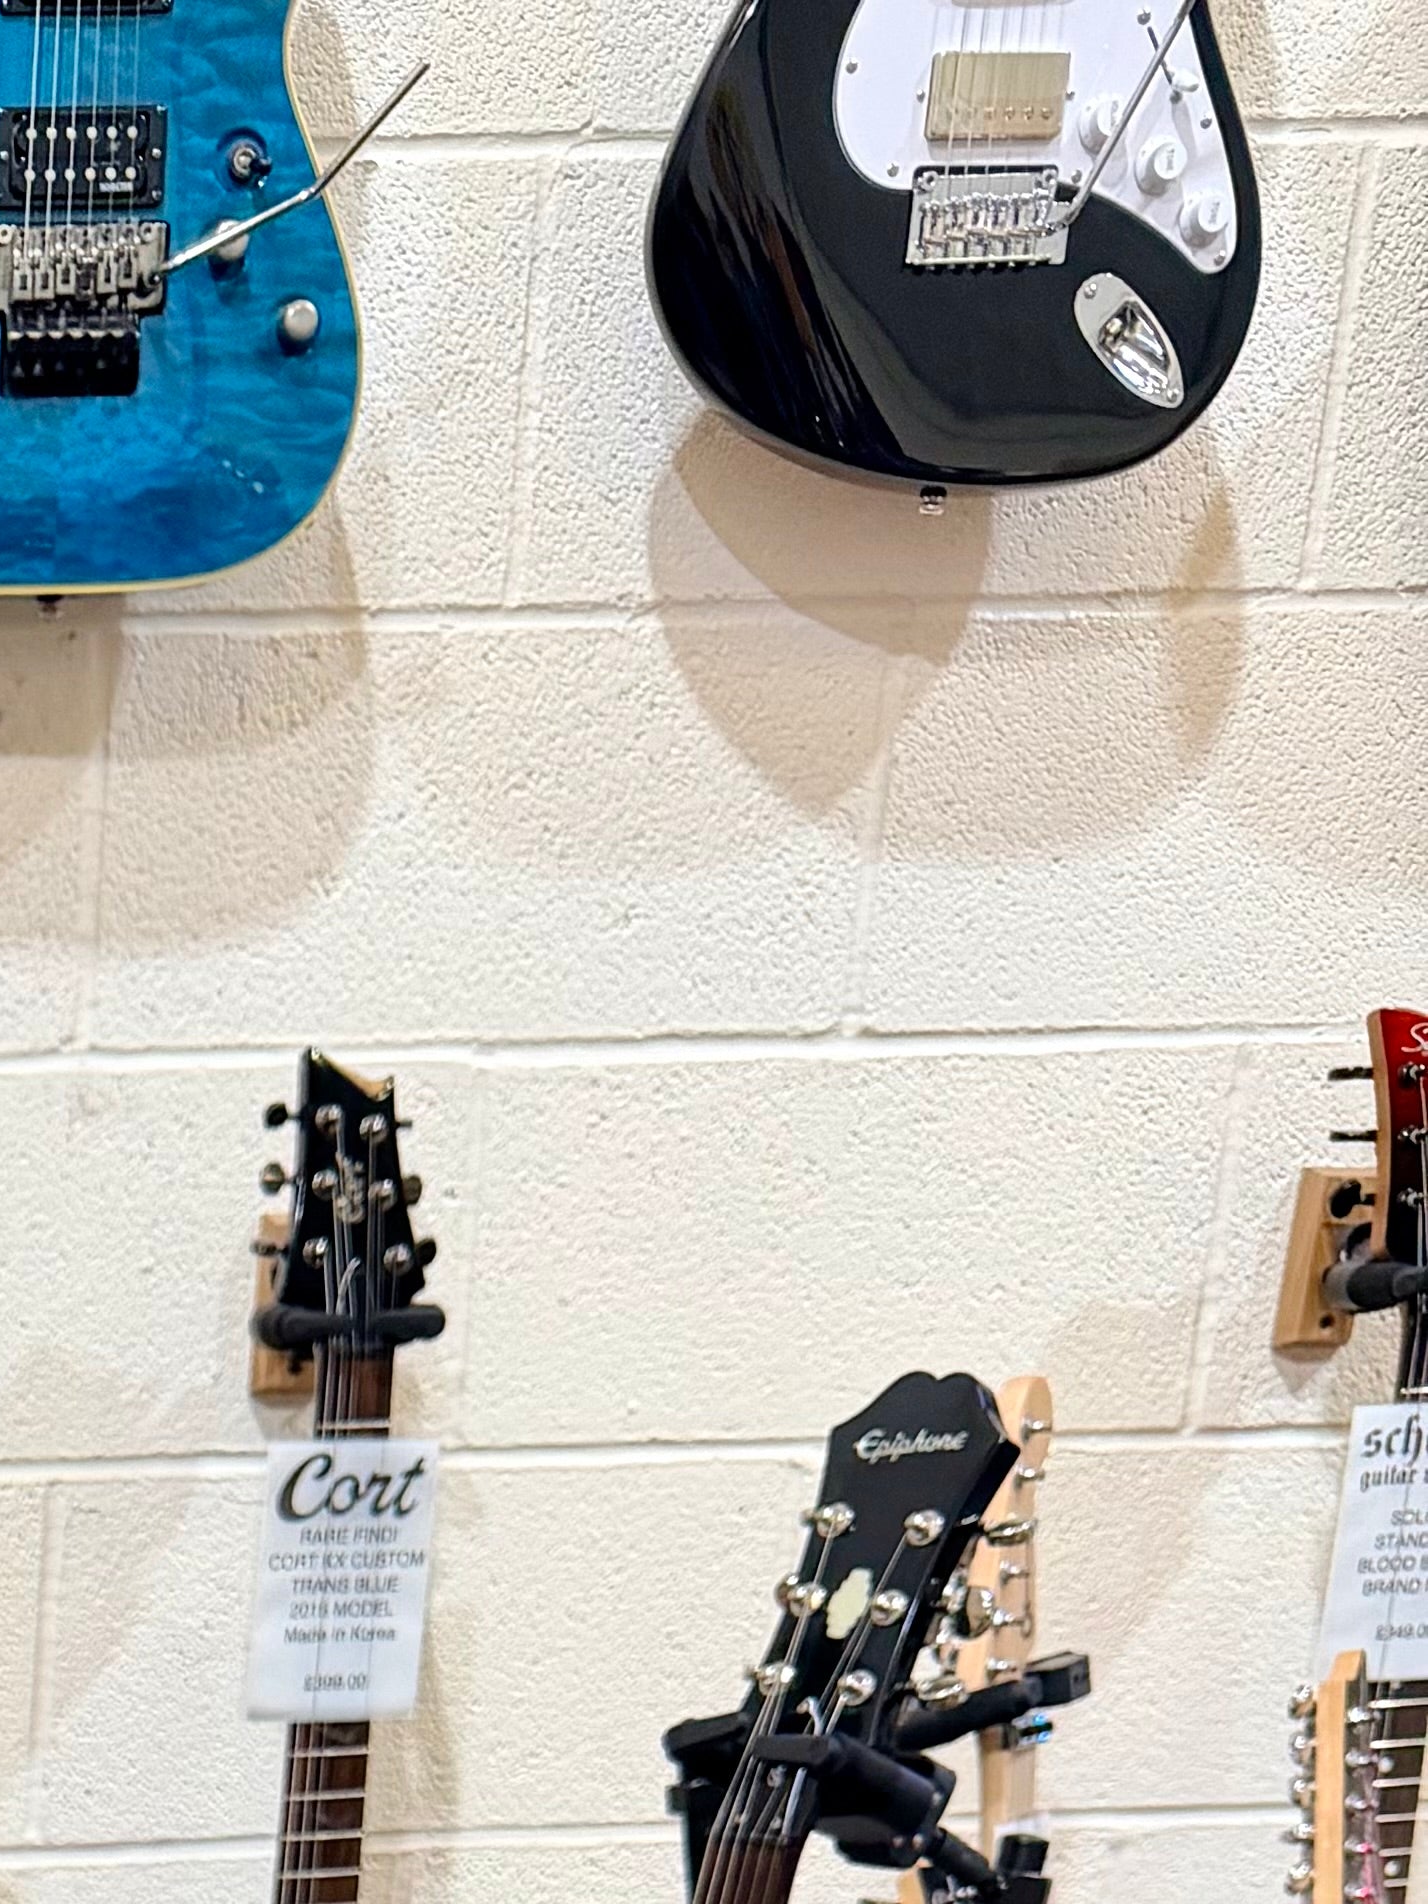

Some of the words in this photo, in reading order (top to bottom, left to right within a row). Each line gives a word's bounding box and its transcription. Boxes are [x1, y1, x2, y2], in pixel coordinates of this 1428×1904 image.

[853, 1428, 970, 1465] Epiphone
[276, 1453, 425, 1523] Cort
[299, 1526, 348, 1545] RARE
[268, 1553, 318, 1573] CORT
[350, 1550, 426, 1572] CUSTOM
[293, 1577, 352, 1594] TRANS
[354, 1576, 401, 1594] BLUE
[332, 1599, 394, 1618] MODEL
[284, 1627, 326, 1644] Made
[350, 1623, 397, 1642] Korea
